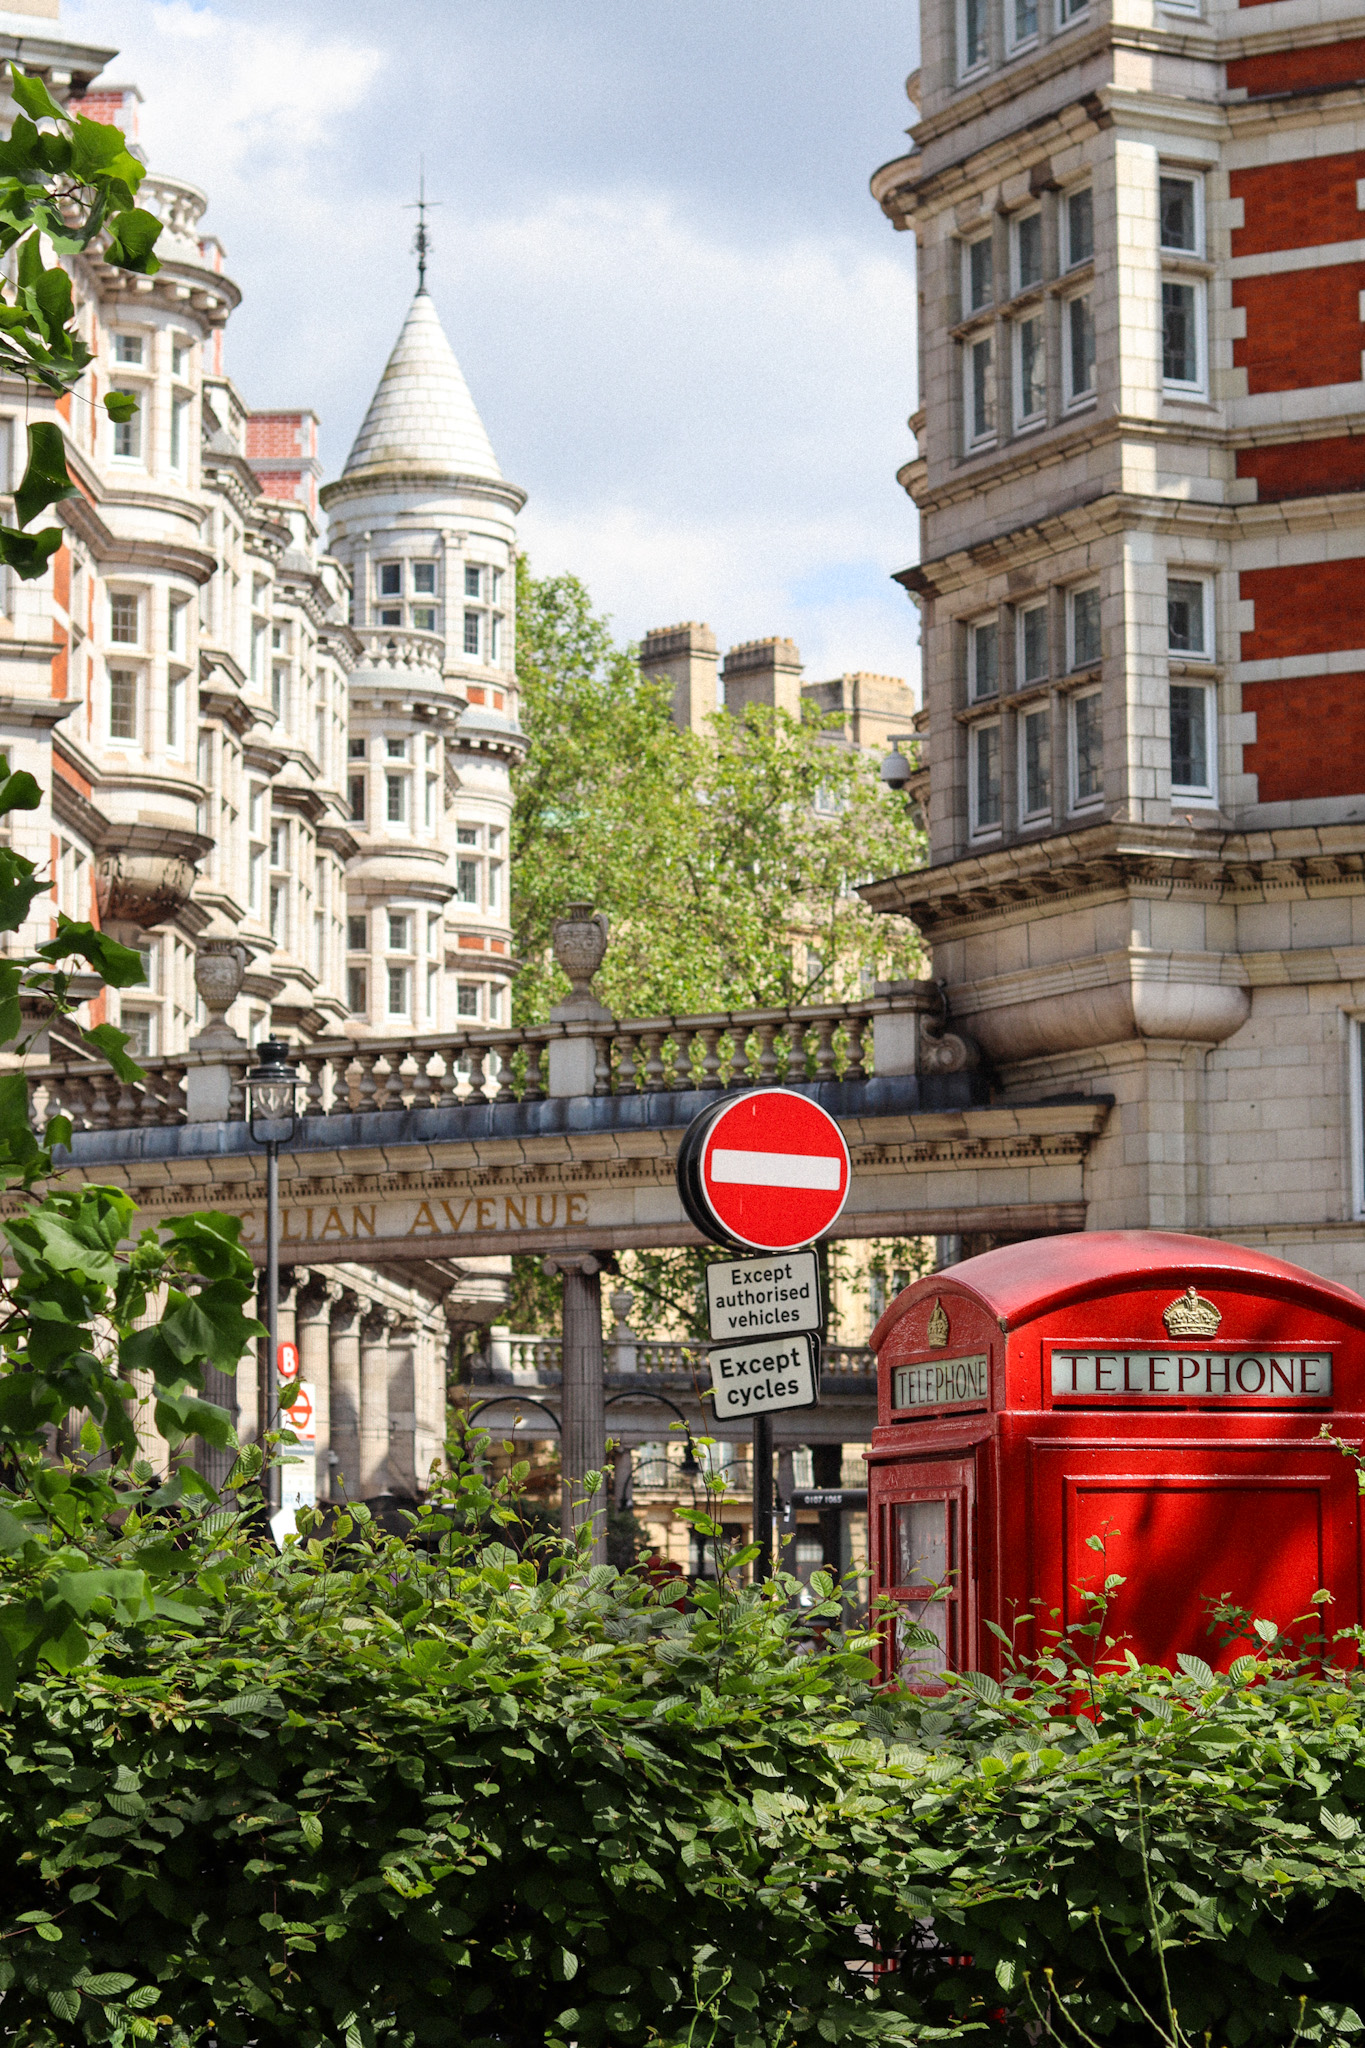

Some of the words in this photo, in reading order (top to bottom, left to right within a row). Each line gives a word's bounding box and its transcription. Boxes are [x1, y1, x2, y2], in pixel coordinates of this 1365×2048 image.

[238, 1204, 376, 1241] CILIAN
[405, 1192, 588, 1235] AVENUE
[731, 1264, 792, 1285] Except
[716, 1283, 810, 1308] authorised
[728, 1308, 800, 1328] vehicles
[282, 1346, 296, 1374] B
[719, 1348, 801, 1379] Except
[898, 1360, 987, 1405] TELEPHONE
[1060, 1356, 1321, 1393] TELEPHONE
[727, 1379, 799, 1407] cycles
